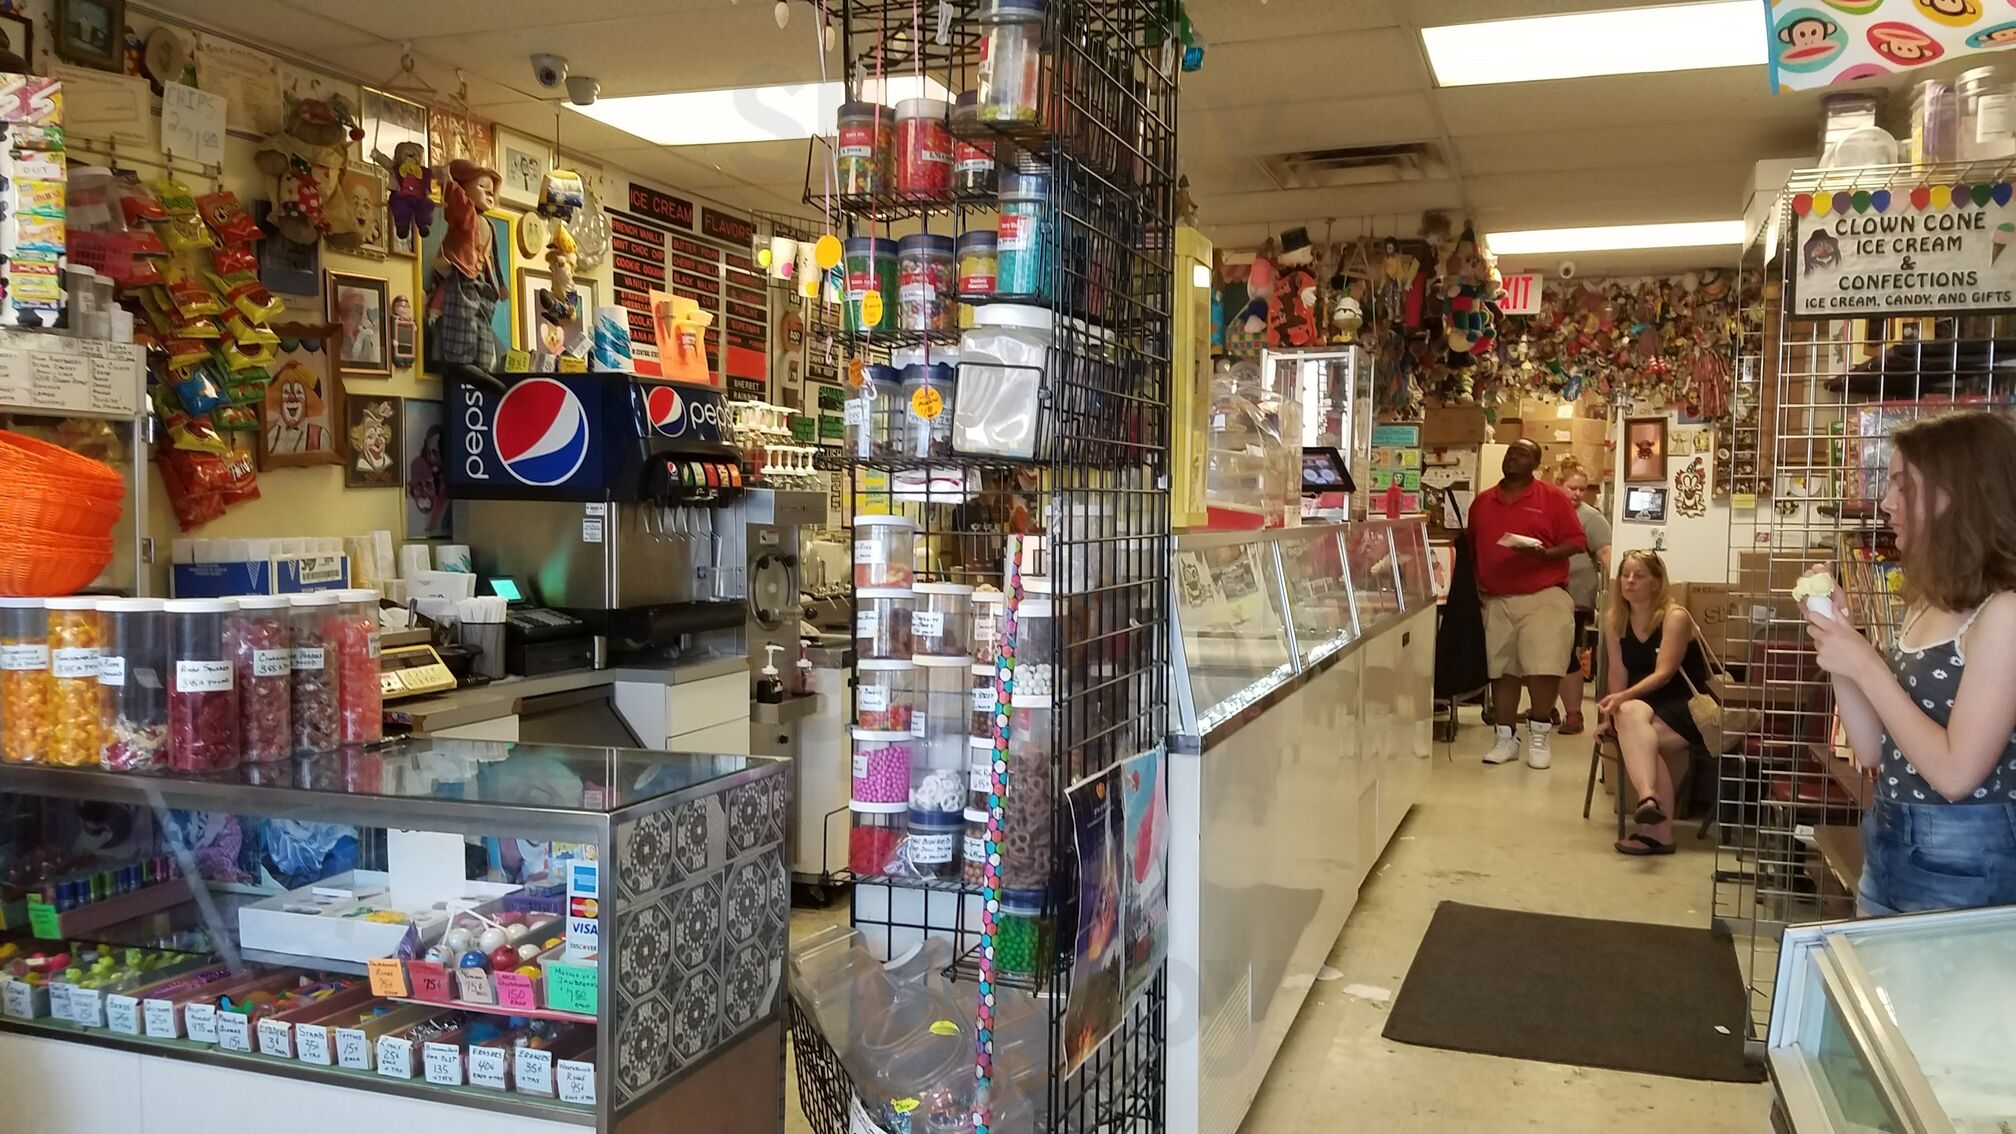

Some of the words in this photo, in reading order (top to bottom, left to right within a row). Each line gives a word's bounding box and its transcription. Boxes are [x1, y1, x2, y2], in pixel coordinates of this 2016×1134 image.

[167, 87, 217, 119] CHIPS
[23, 166, 48, 174] OUT
[630, 188, 649, 210] ICE
[652, 197, 693, 223] CREAM
[612, 220, 638, 235] FRENCH
[639, 226, 664, 243] VANILLA
[704, 214, 751, 242] FLAVORS
[1835, 216, 1915, 235] CLOWN
[1923, 212, 1986, 232] CONE
[612, 237, 630, 251] MINT
[631, 243, 649, 257] CHOC
[673, 239, 697, 254] BUTTER
[1856, 239, 1885, 255] ICE
[1892, 236, 1962, 253] CREAM
[615, 255, 641, 269] COOKIE
[1900, 256, 1916, 270] &
[674, 272, 693, 285] BLACK
[697, 279, 719, 292] WALNUT
[1838, 271, 1978, 290] CONFECTIONS
[1500, 276, 1532, 310] XIT
[1805, 298, 1826, 309] ICE
[1937, 292, 1967, 305] AND
[1971, 291, 2012, 304] GIFTS
[731, 320, 760, 334] SUPERMAN
[734, 379, 760, 391] SHERBET
[461, 383, 489, 479] pepsi
[572, 922, 598, 935] VISA
[384, 1049, 401, 1060] 25¢
[433, 1064, 449, 1074] 135
[478, 1061, 495, 1071] 40¢
[525, 1062, 543, 1074] 35¢
